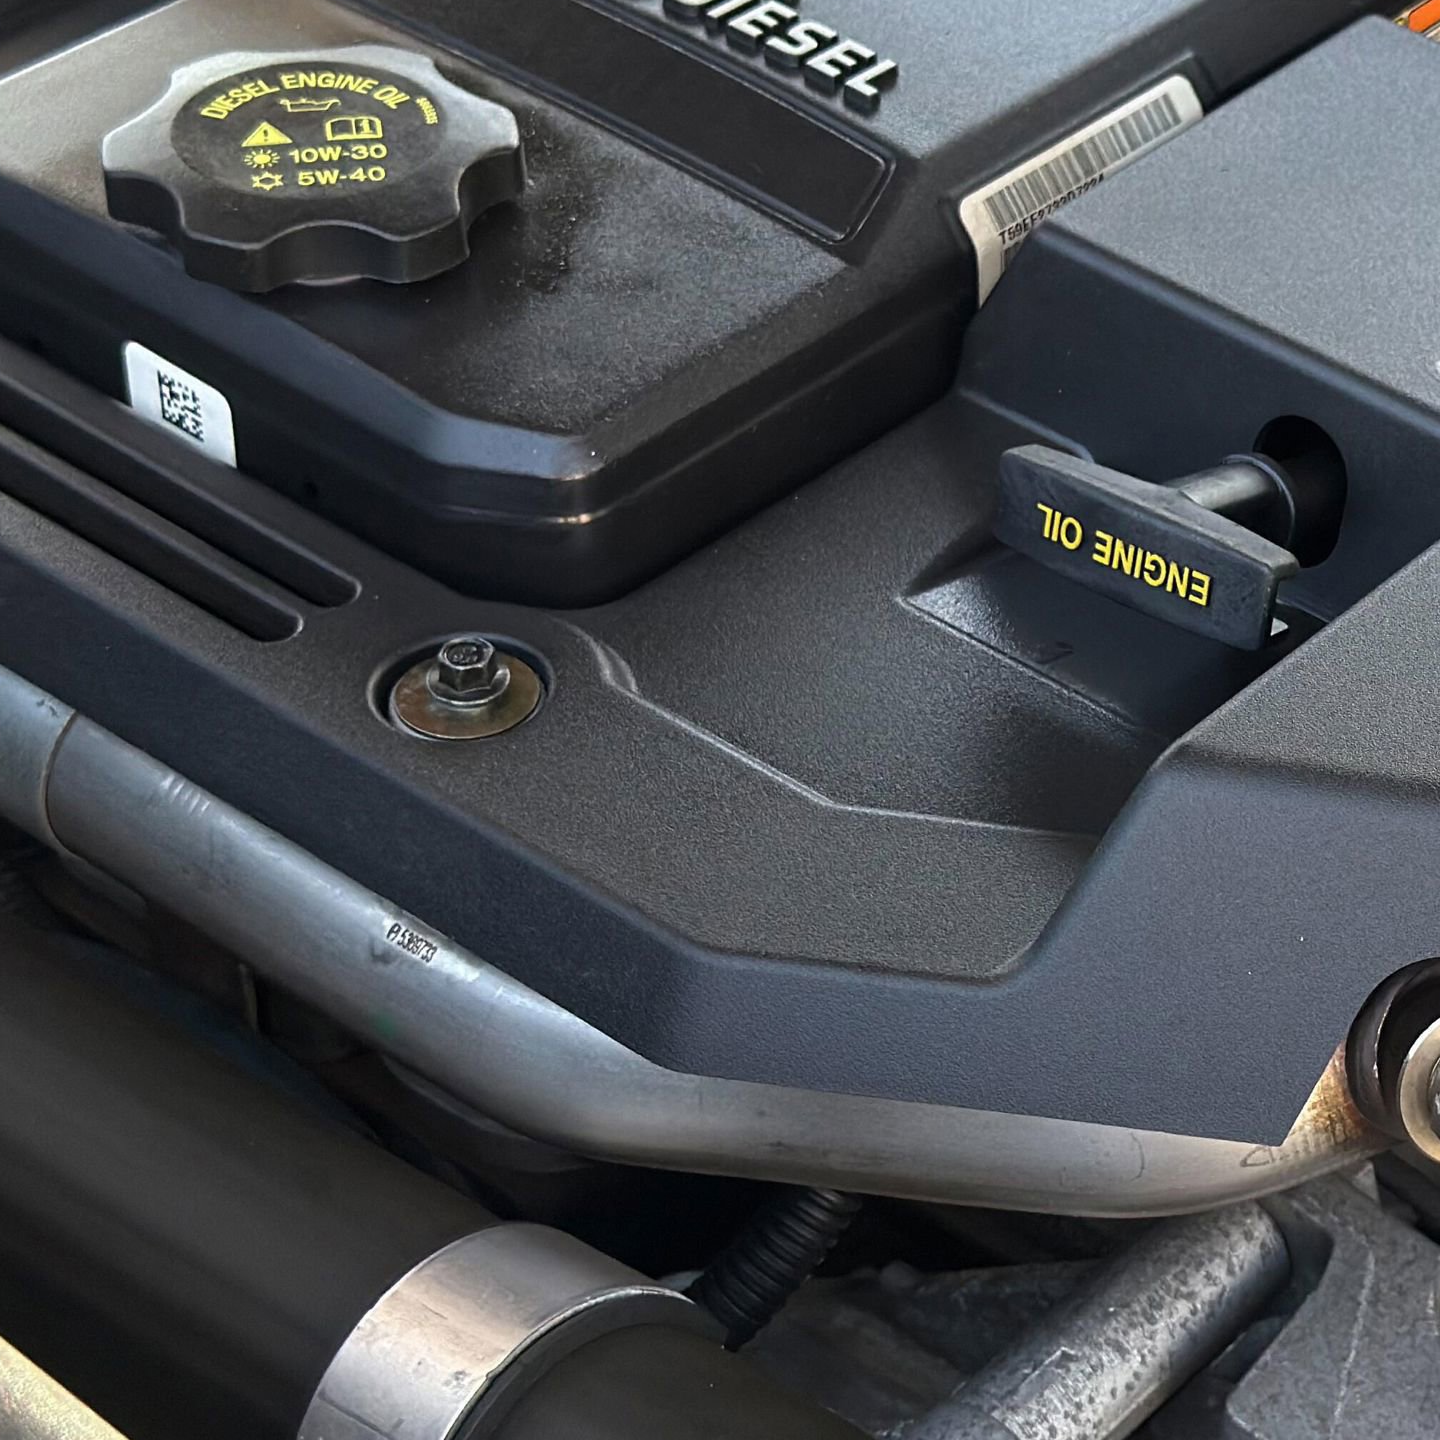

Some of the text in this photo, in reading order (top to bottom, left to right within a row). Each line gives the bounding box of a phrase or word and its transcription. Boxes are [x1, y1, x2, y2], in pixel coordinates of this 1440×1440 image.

[200, 72, 410, 120] DIESEL ENGINE OIL
[289, 143, 388, 164] 10W-30
[297, 166, 386, 186] 5W-40
[1037, 502, 1211, 607] ENGINE OIL
